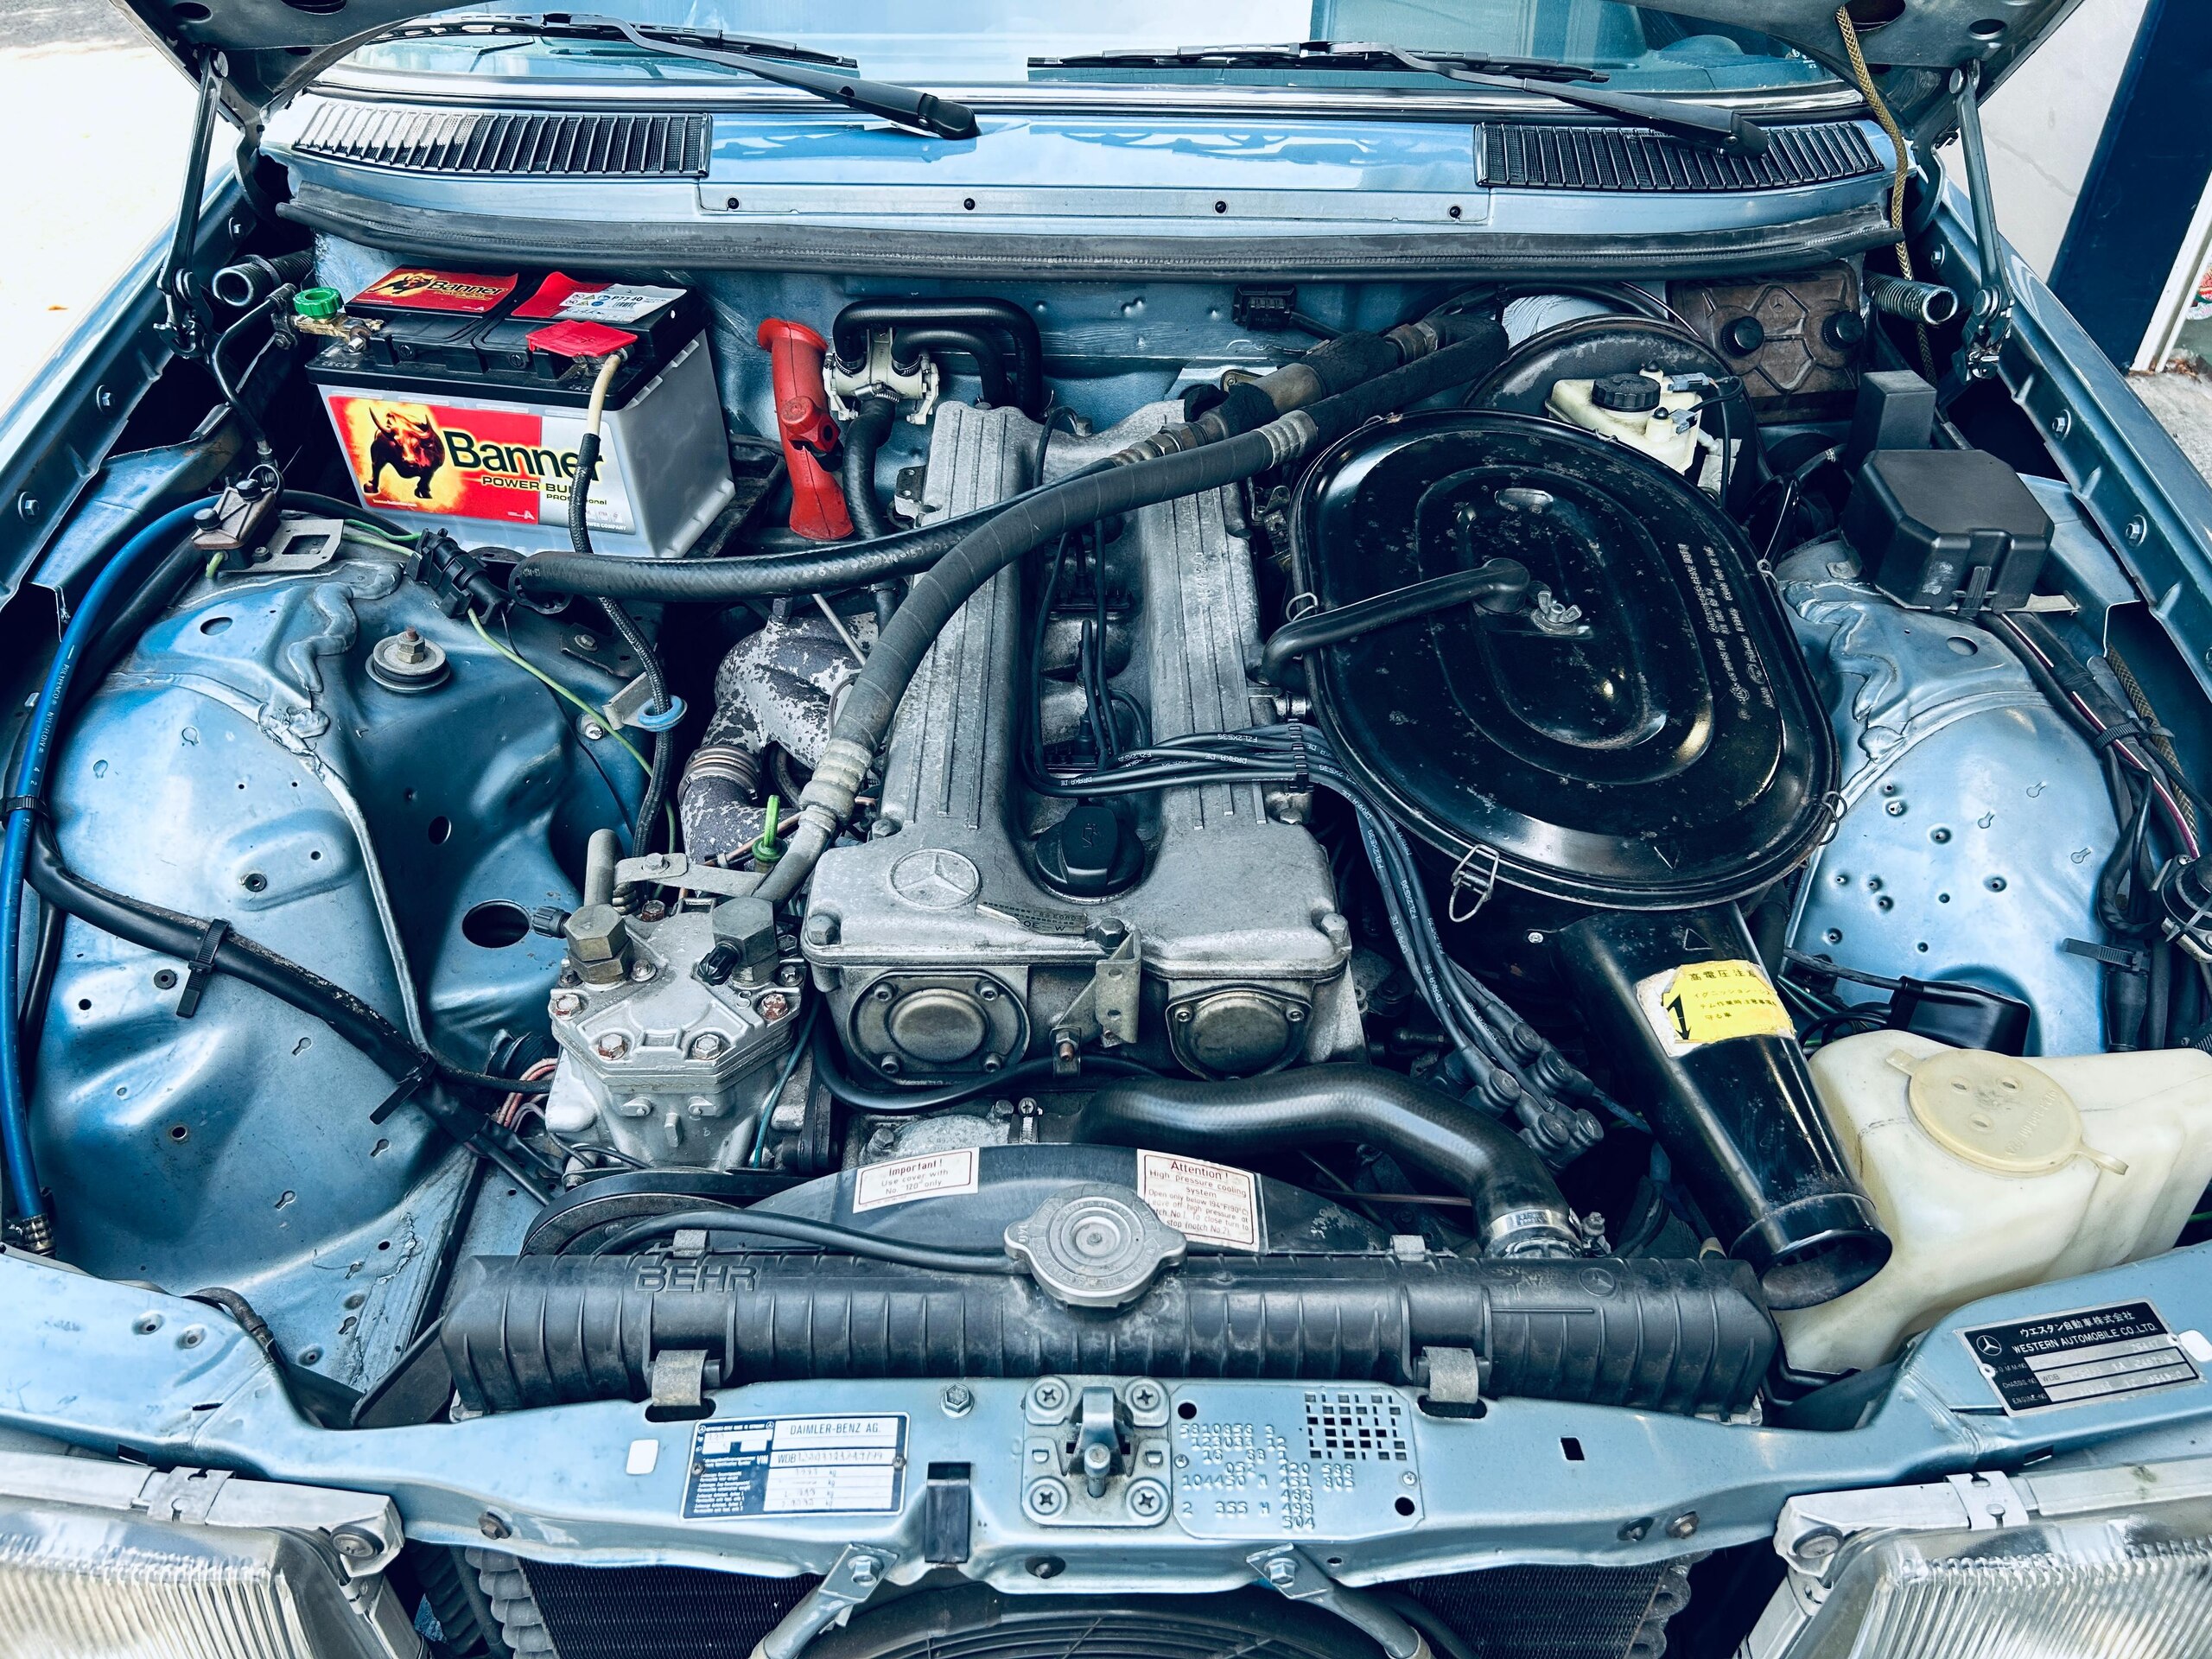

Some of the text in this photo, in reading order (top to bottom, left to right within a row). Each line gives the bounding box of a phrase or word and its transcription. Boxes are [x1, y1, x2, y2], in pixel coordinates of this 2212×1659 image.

[427, 281, 506, 295] Banner
[482, 477, 571, 493] POWER BU
[1220, 754, 1248, 765] DRAKA
[1351, 798, 1372, 820] DRAKA
[888, 1160, 937, 1176] Important
[1171, 1160, 1223, 1180] Attention
[902, 1173, 925, 1183] cover
[925, 1179, 943, 1188] only
[1149, 1169, 1247, 1198] High pressure cooling
[1148, 1188, 1167, 1198] Open
[1169, 1192, 1183, 1201] only
[1186, 1195, 1207, 1205] below
[1185, 1186, 1217, 1198] system
[1173, 1199, 1183, 1208] off
[1187, 1202, 1202, 1212] high
[1205, 1209, 1236, 1220] pressure
[1166, 1218, 1182, 1228] stop
[1205, 1214, 1223, 1224] close
[1225, 1219, 1240, 1228] turn
[636, 1265, 757, 1293] BEHR
[2020, 1310, 2135, 1338] ウエスタン自動車株式会社
[2012, 1338, 2058, 1355] WESTERN
[2061, 1328, 2120, 1346] AUTOMOBILE
[790, 1424, 861, 1435] DAIMLER-BENZ
